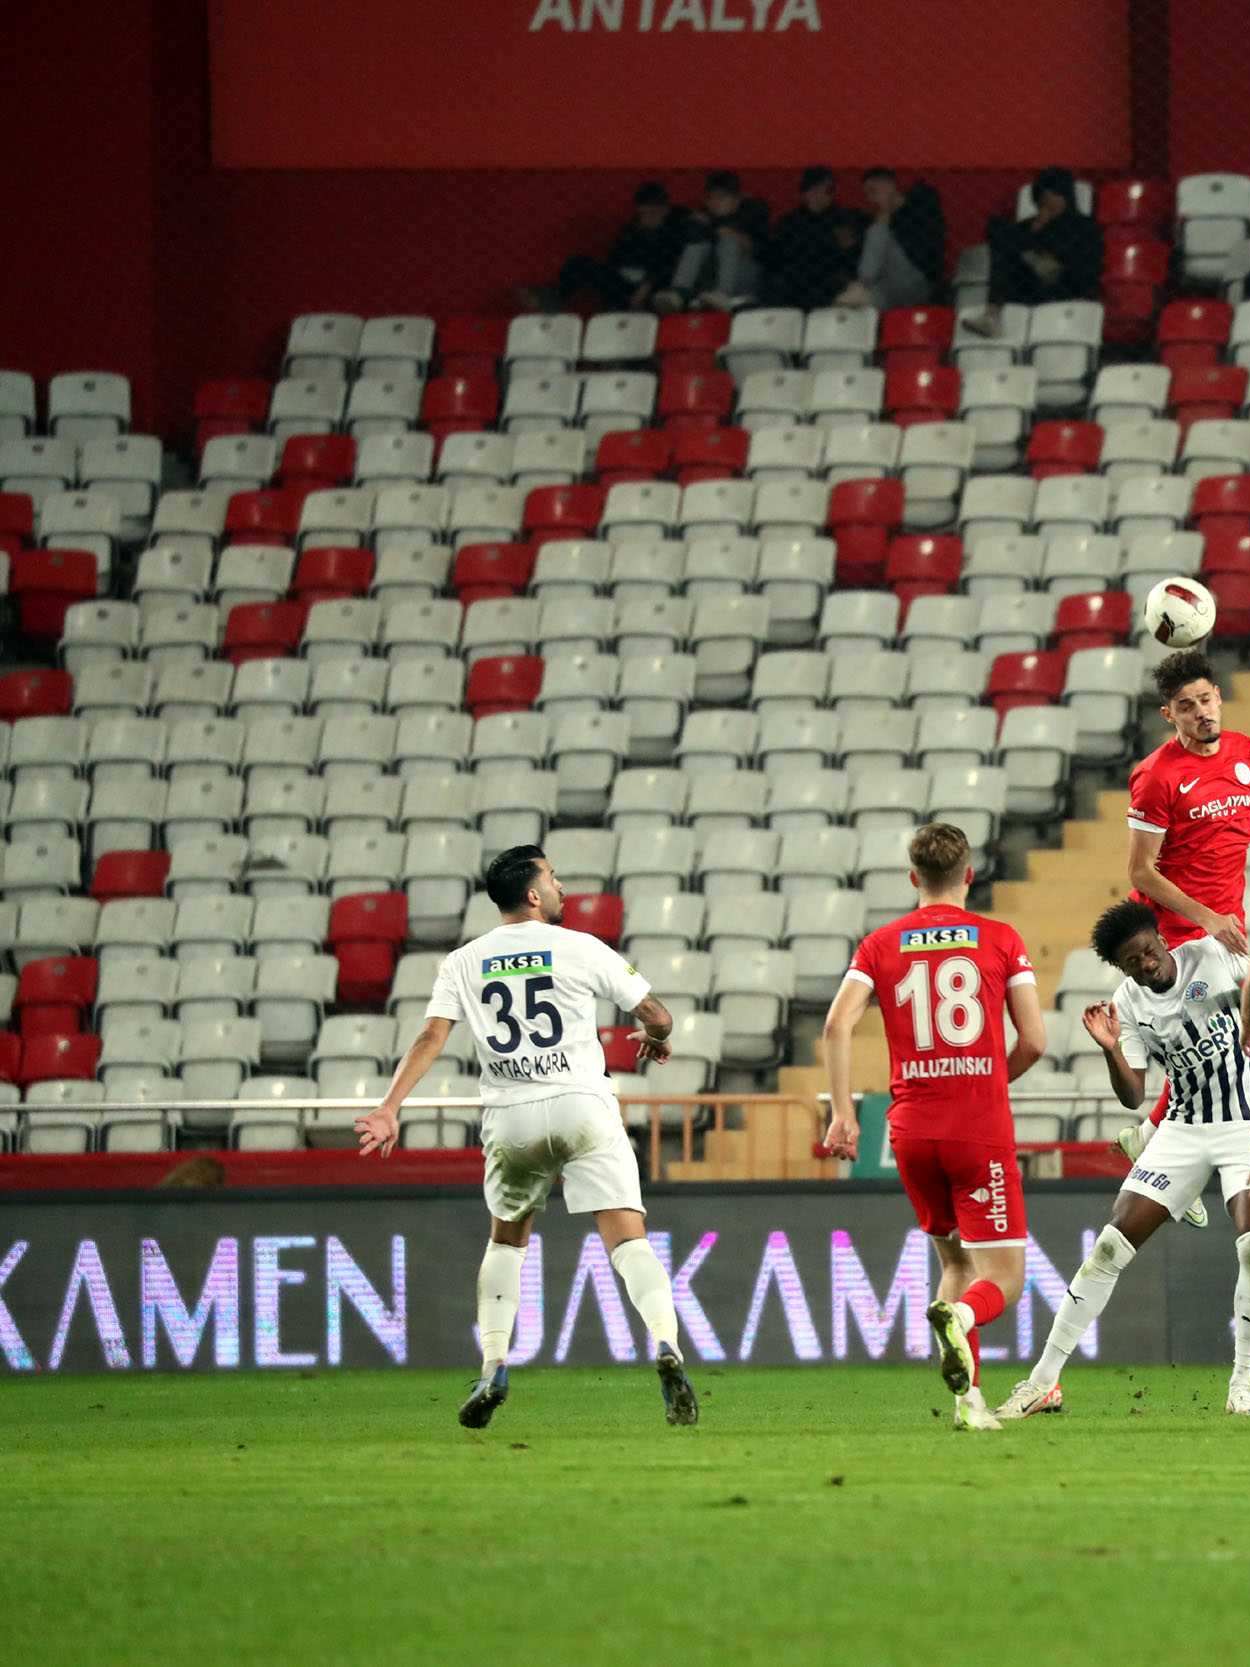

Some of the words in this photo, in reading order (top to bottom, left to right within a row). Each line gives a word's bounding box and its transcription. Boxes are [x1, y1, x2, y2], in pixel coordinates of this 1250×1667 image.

[489, 954, 545, 972] aksa
[909, 928, 969, 946] aksa
[481, 976, 563, 1053] 35
[895, 956, 985, 1051] 18
[488, 1056, 532, 1080] AYTAÇ
[534, 1051, 571, 1076] KARA
[472, 1230, 1099, 1364] JAKAMN
